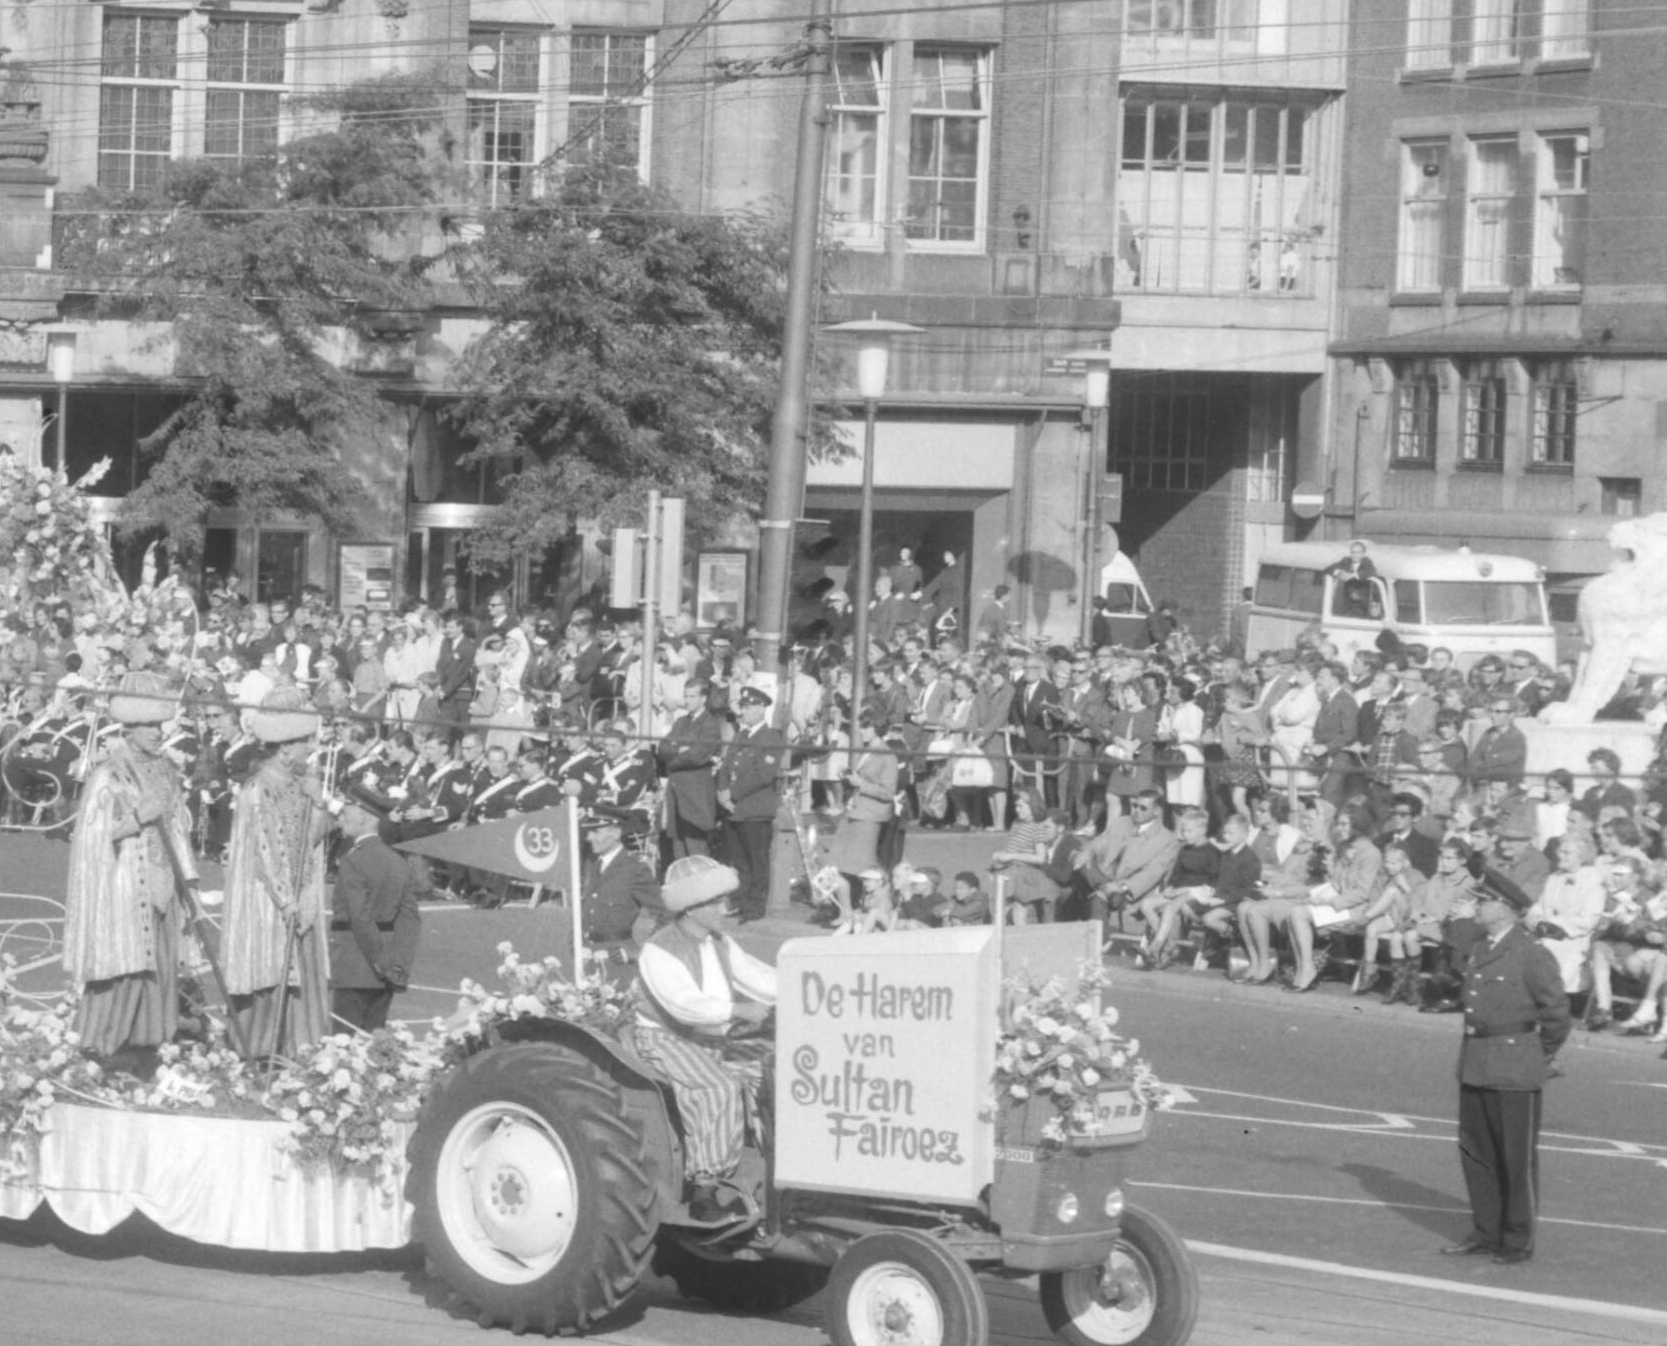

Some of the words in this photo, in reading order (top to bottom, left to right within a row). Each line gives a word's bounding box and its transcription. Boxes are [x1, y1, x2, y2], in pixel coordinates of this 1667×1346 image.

[526, 826, 555, 854] 33
[800, 970, 845, 1020] De
[849, 971, 955, 1022] Harem
[842, 1031, 896, 1059] van
[790, 1043, 916, 1116] Sultan
[828, 1112, 965, 1166] Fairoez
